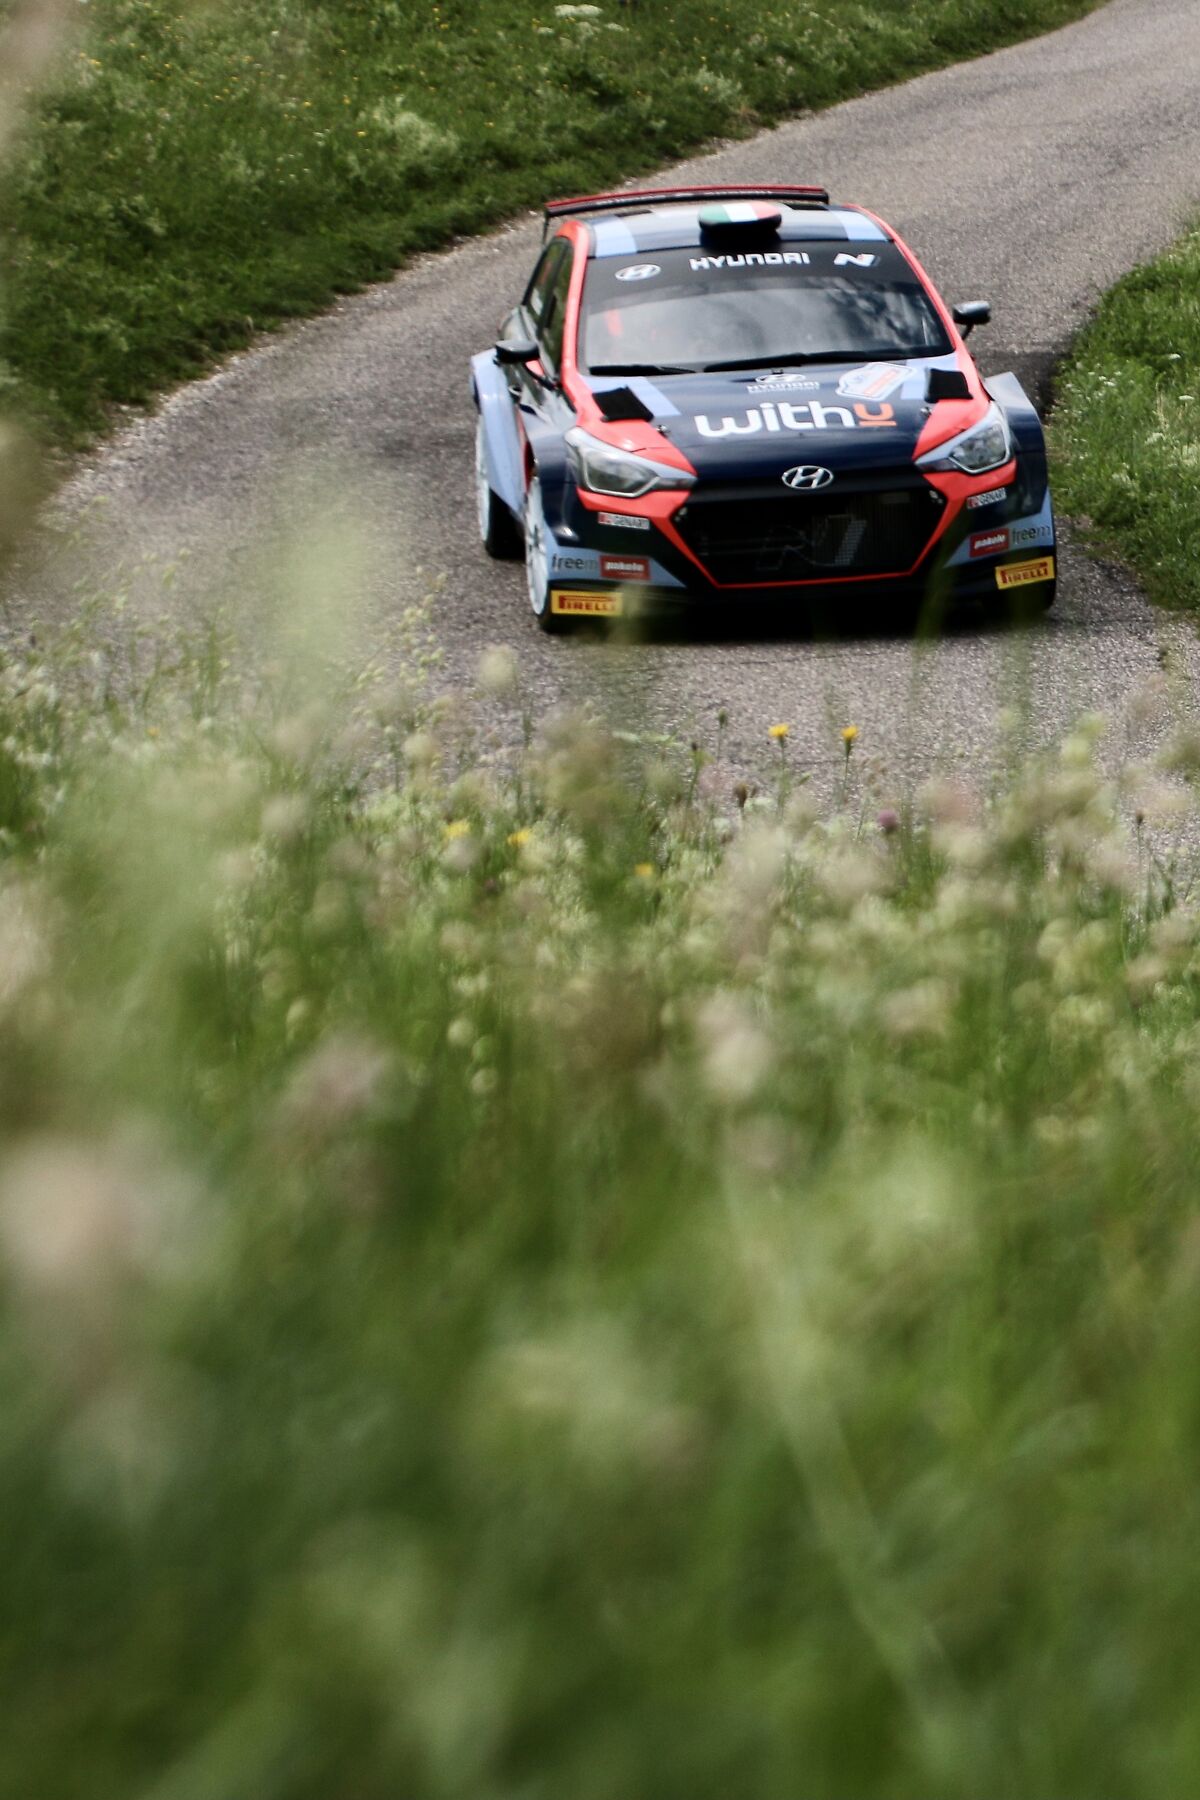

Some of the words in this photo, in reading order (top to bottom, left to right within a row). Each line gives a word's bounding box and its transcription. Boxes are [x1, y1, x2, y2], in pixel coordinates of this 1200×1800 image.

[689, 252, 810, 271] HYUNDAI
[747, 381, 819, 392] HYUNDAI
[695, 400, 897, 437] withu
[1000, 561, 1049, 584] PIRELLI
